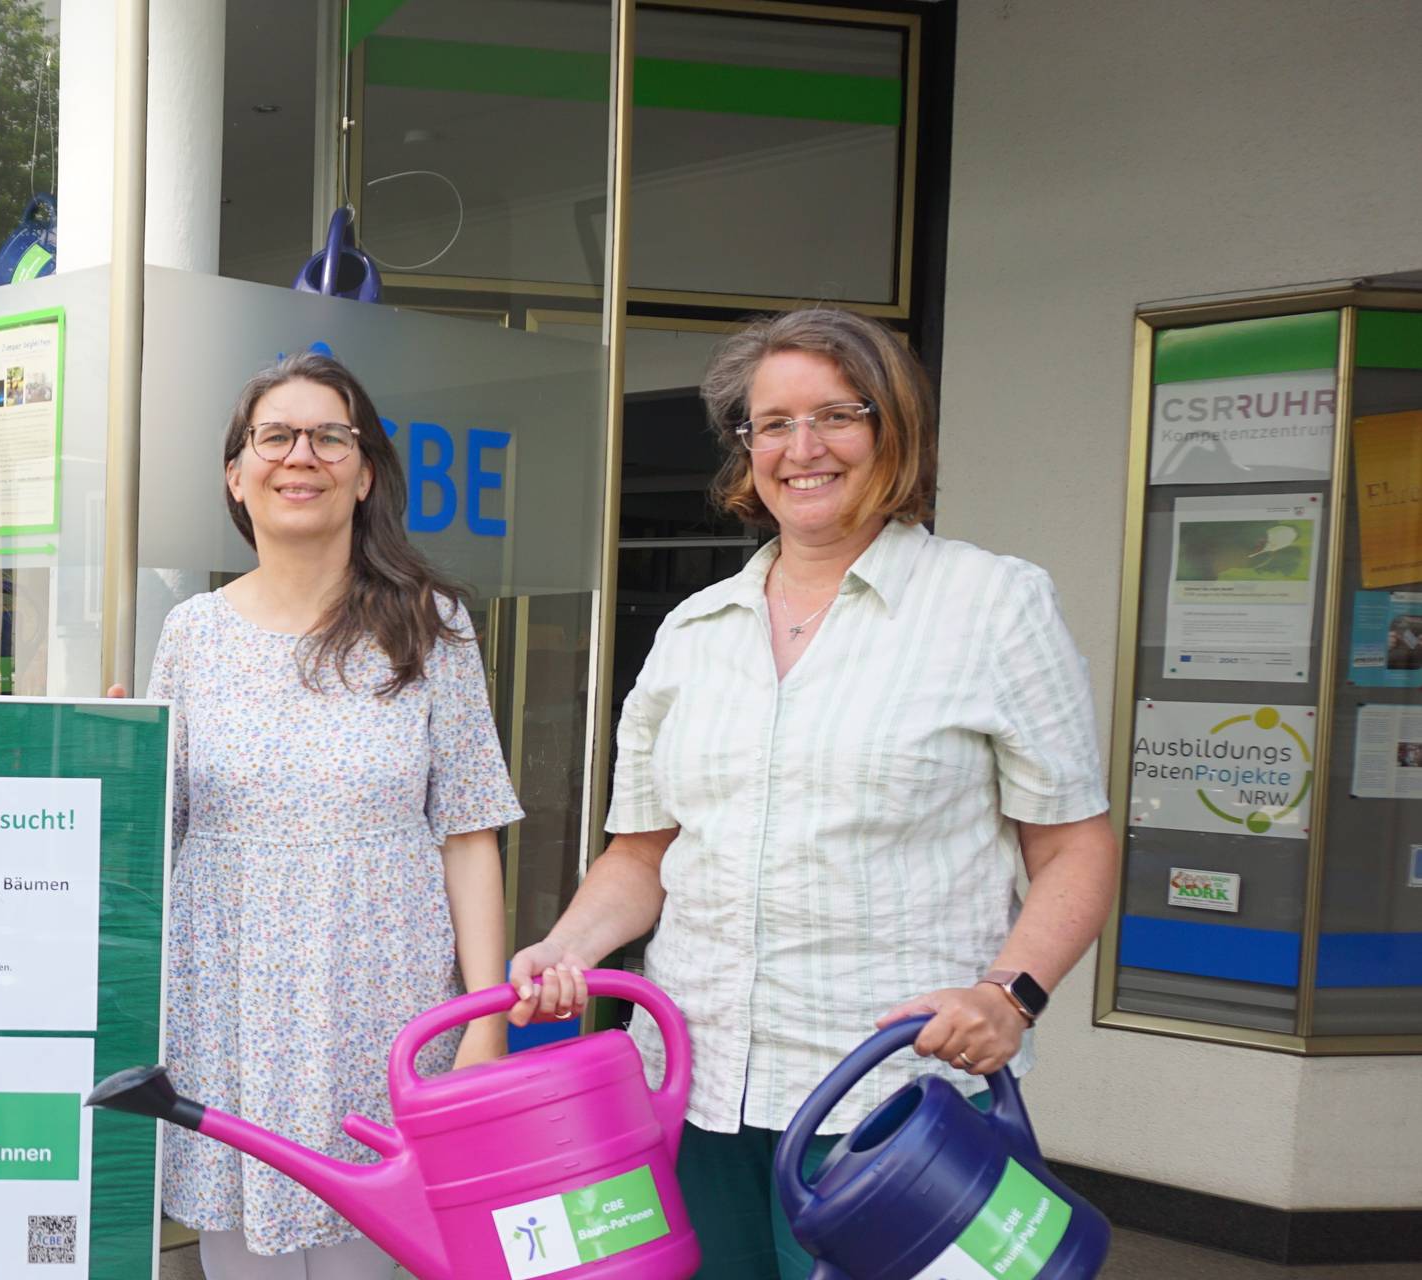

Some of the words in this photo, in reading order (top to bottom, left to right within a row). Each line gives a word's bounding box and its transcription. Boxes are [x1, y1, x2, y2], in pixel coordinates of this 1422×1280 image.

[376, 415, 512, 538] BE
[1134, 737, 1292, 765] Ausbildungs
[1134, 761, 1291, 787] PatenProjekte
[1239, 789, 1289, 806] NRW
[3, 877, 70, 891] Bäumen
[601, 1198, 625, 1214] CBE
[1002, 1206, 1024, 1233] CBE
